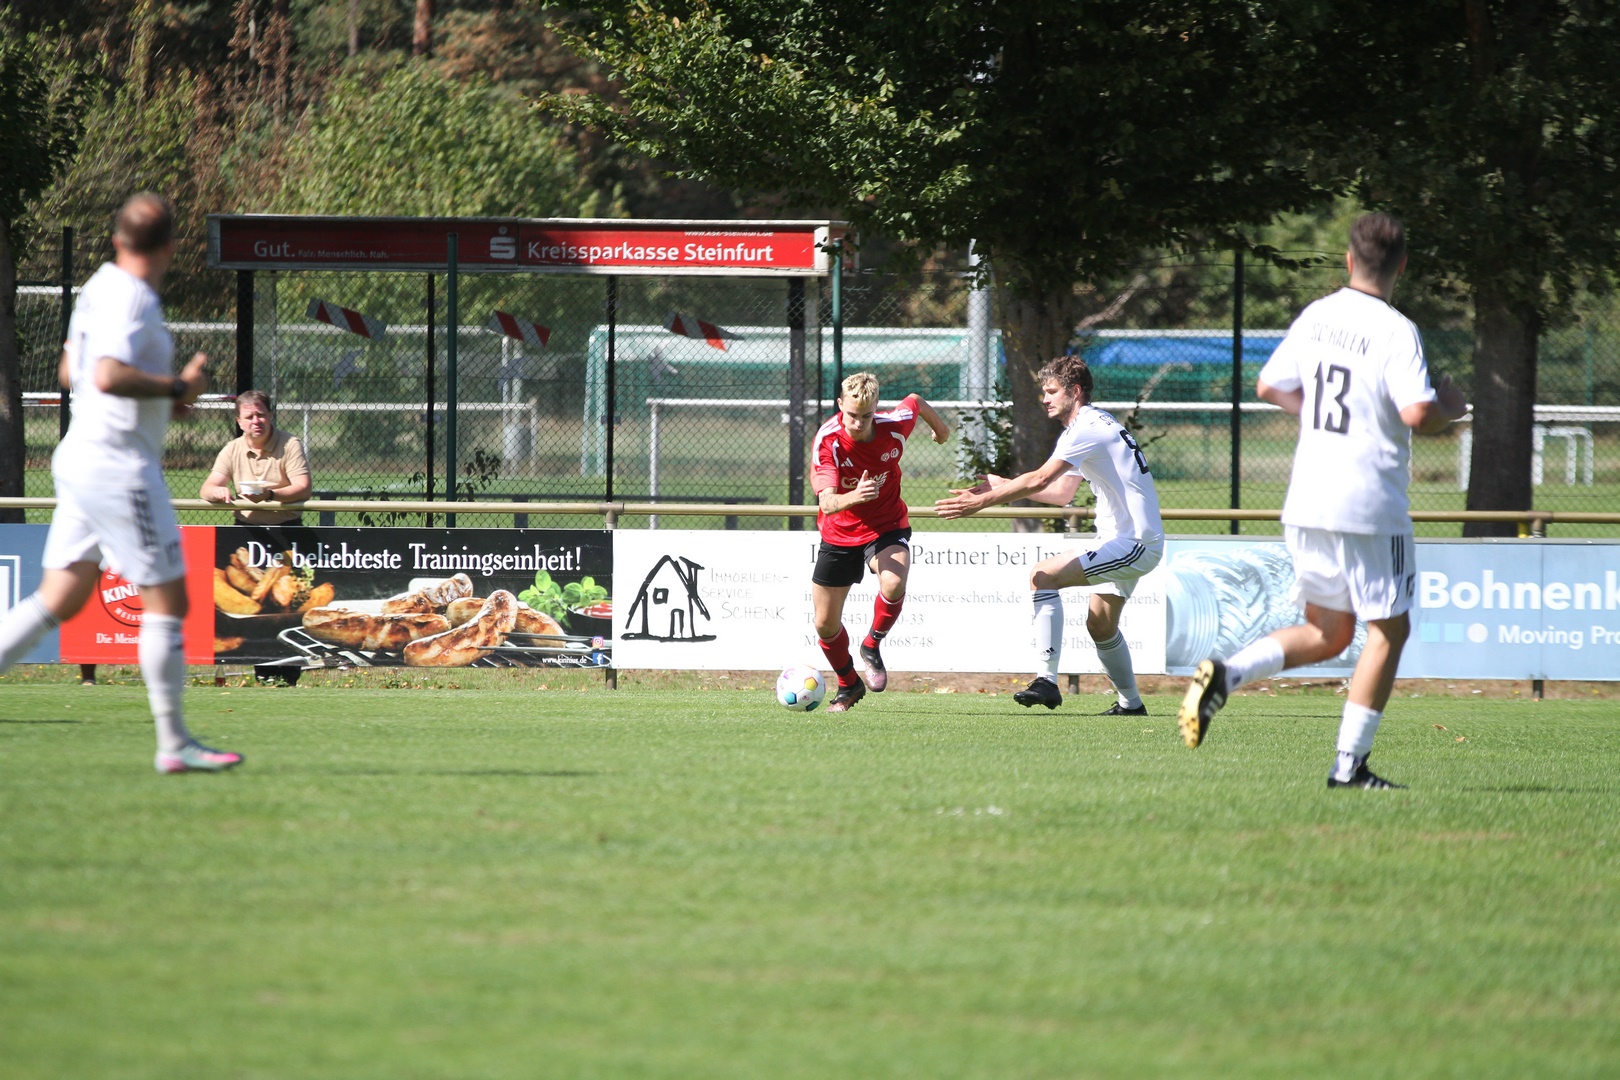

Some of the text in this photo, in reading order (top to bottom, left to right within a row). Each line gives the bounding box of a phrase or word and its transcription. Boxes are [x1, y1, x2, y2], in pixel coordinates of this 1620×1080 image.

[253, 240, 296, 257] Gut.
[527, 241, 773, 263] Kreissparkasse Steinfurt
[1313, 361, 1351, 435] 13
[247, 541, 581, 577] Die beliebteste Trainingseinheit!
[912, 544, 990, 565] Partner
[997, 544, 1027, 566] bei
[96, 632, 113, 644] Die
[1499, 625, 1584, 651] Moving
